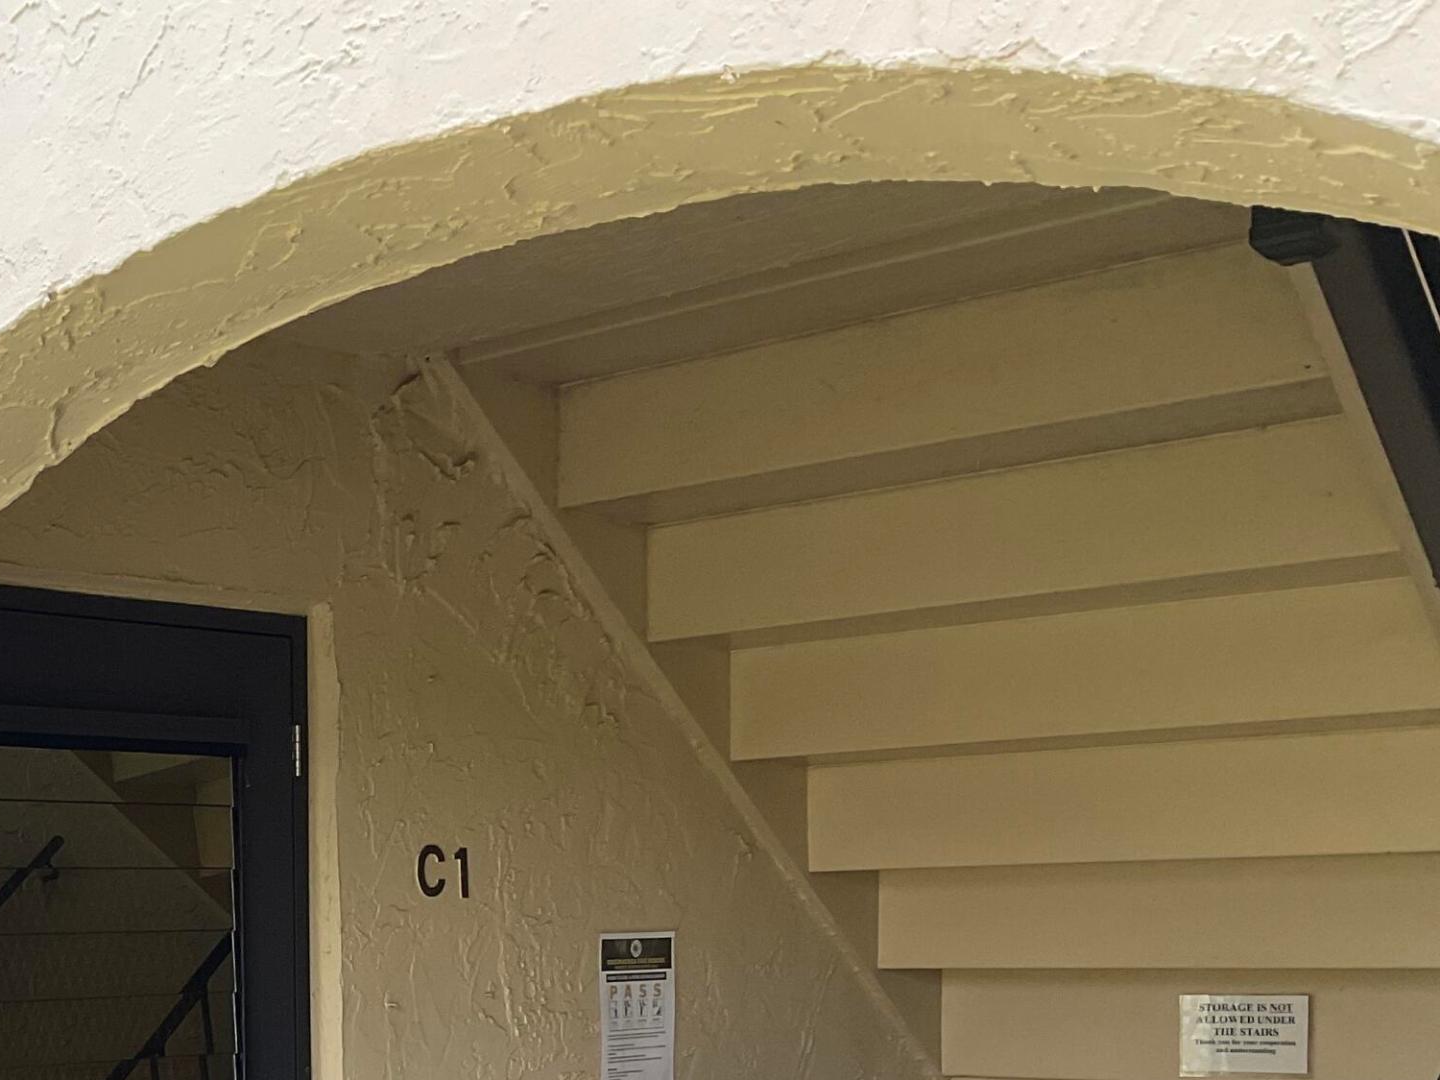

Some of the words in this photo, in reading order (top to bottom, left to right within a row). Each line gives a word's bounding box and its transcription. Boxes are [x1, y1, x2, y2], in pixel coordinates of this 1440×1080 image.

[417, 844, 470, 899] C1
[1199, 1003, 1253, 1012] STORAGE
[1257, 1003, 1267, 1012] IS
[1269, 1003, 1293, 1013] NOT
[1195, 1015, 1255, 1024] ALLOWED
[1257, 1015, 1296, 1024] UNDER
[1213, 1027, 1237, 1036] THE
[1239, 1027, 1280, 1037] STAIRS
